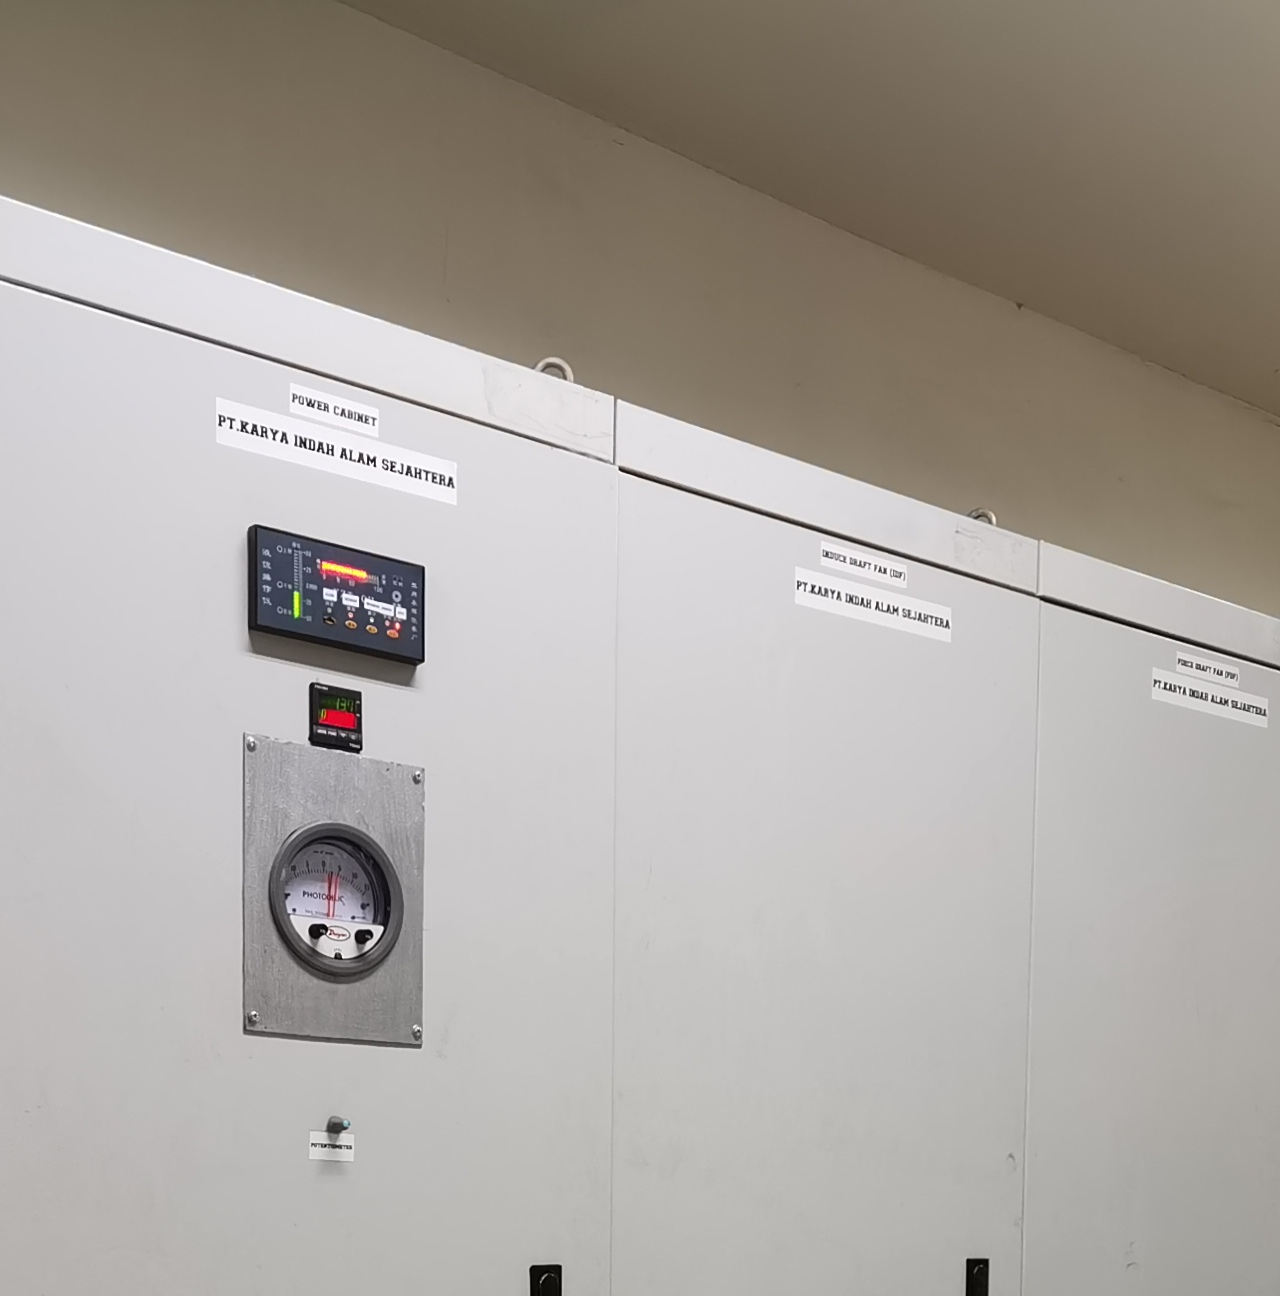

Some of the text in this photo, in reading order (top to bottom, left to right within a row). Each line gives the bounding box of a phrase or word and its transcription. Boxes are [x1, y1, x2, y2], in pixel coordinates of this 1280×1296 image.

[291, 392, 378, 427] POWER CABINET
[217, 413, 456, 489] PT.KARYA INDAH ALAM SEJAHTERA
[849, 556, 872, 570] DRAFT
[874, 564, 888, 575] FAN
[796, 579, 951, 630] PT.KARYA INDAH ALAM SEJAHTERA
